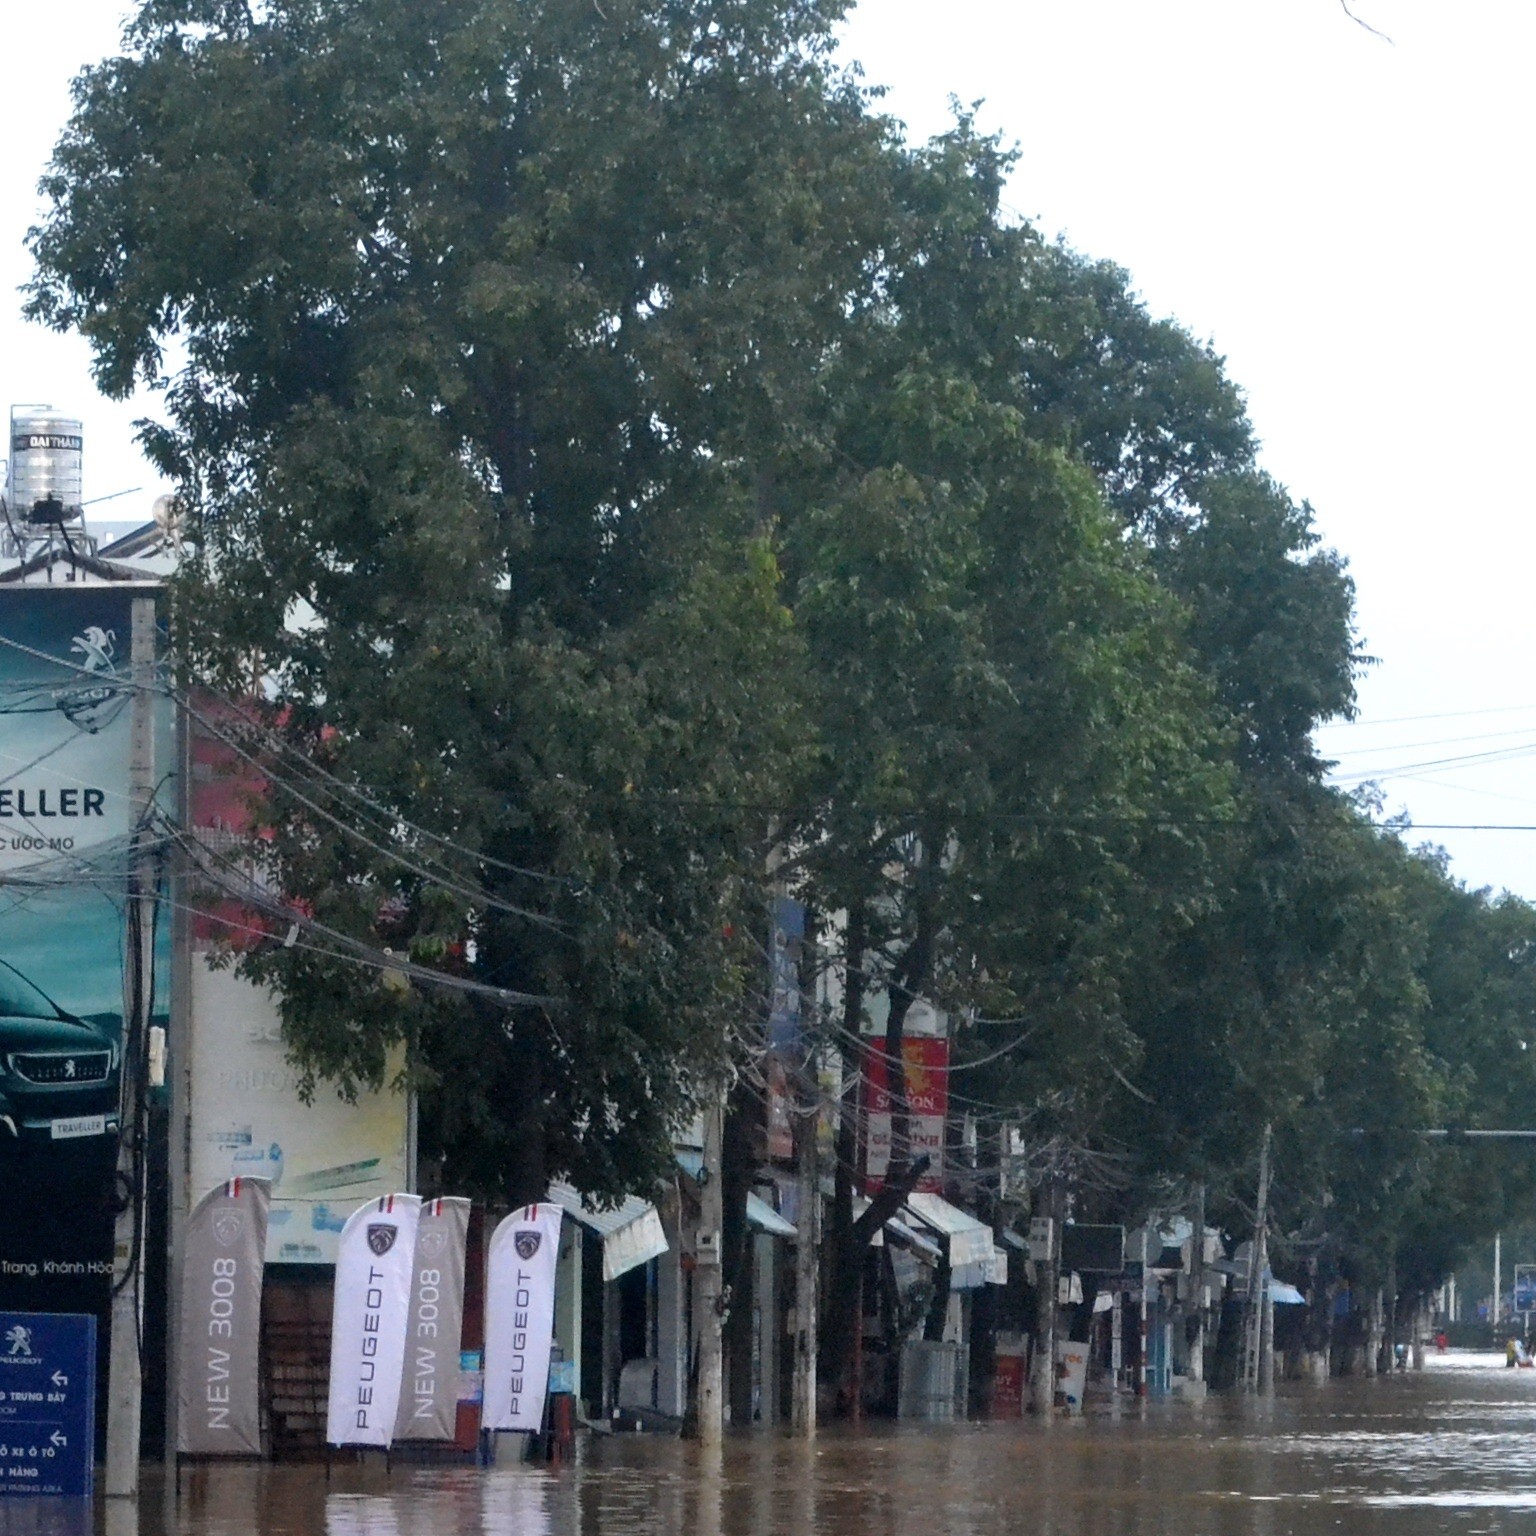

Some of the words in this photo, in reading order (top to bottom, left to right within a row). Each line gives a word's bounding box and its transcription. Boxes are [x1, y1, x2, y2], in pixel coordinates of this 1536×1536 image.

[44, 1260, 84, 1273] Khánh
[209, 1256, 237, 1338] 3008
[418, 1267, 441, 1338] 3008
[356, 1265, 385, 1429] PEUGEOT
[510, 1268, 532, 1416] PEUGEOT
[207, 1346, 231, 1430] NEW
[415, 1345, 436, 1418] NEW
[12, 1447, 25, 1456] XE
